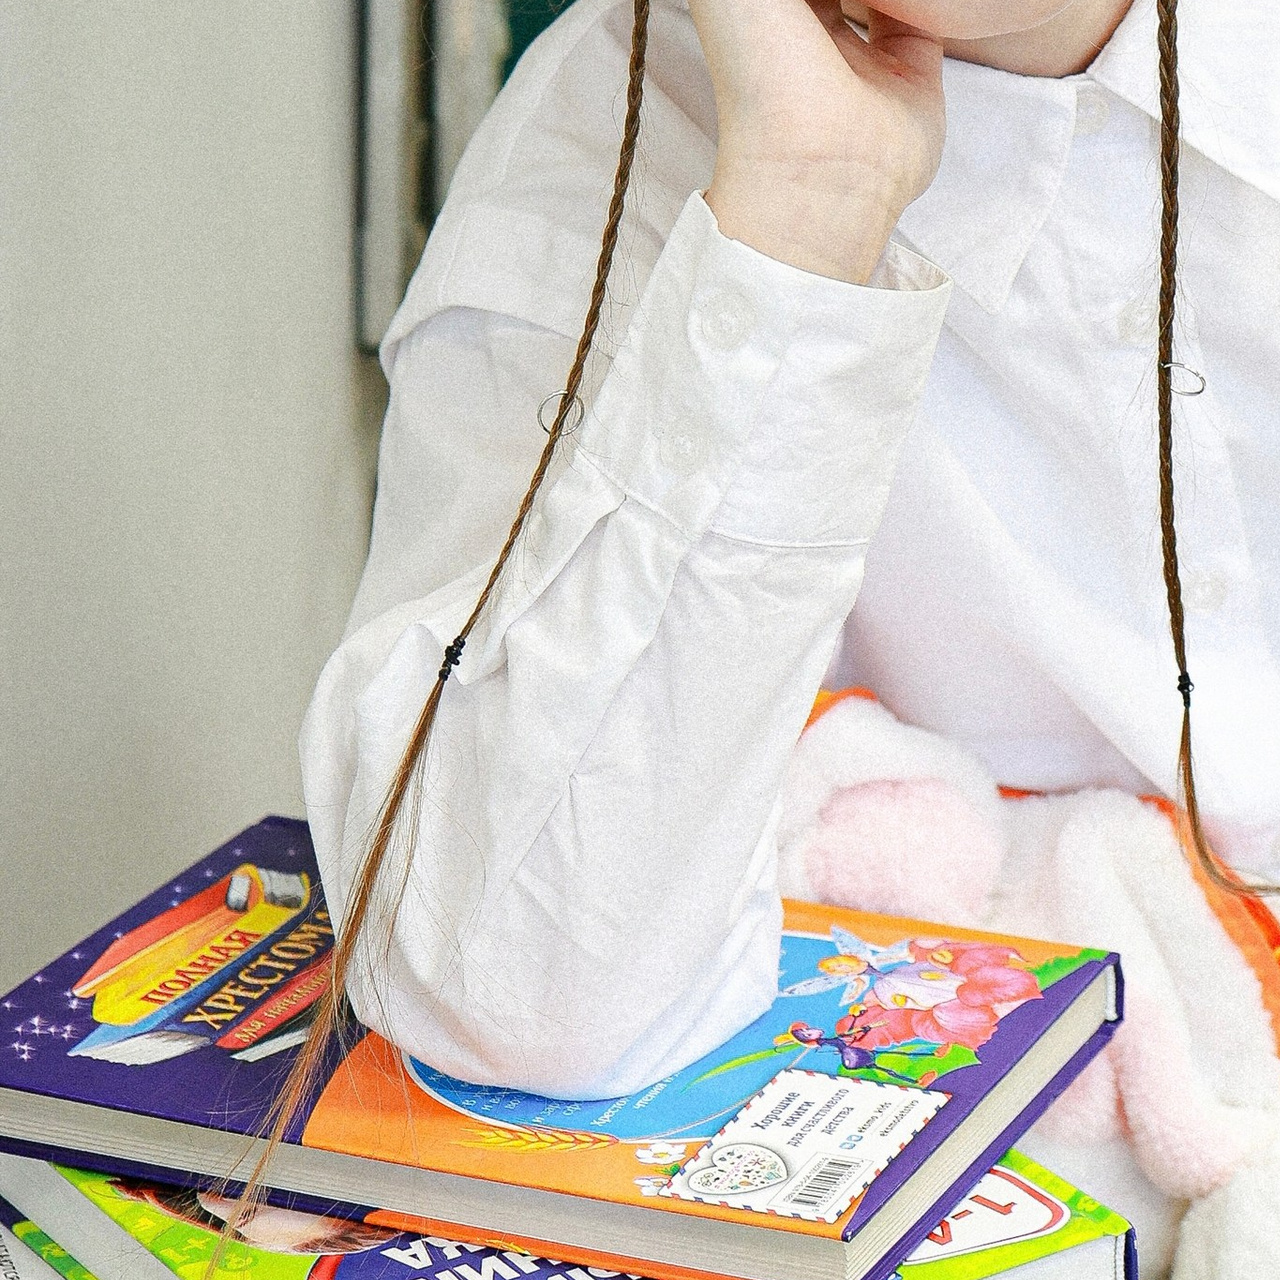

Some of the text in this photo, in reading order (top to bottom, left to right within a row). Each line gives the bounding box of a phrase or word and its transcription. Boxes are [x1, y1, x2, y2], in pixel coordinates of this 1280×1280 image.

[140, 929, 262, 1006] ПОЛНАЯ
[590, 1096, 632, 1128] Хресто
[750, 1091, 801, 1131] Хорошие
[782, 1100, 816, 1128] книги
[787, 1088, 850, 1148] для счастливого
[821, 1105, 855, 1136] детства
